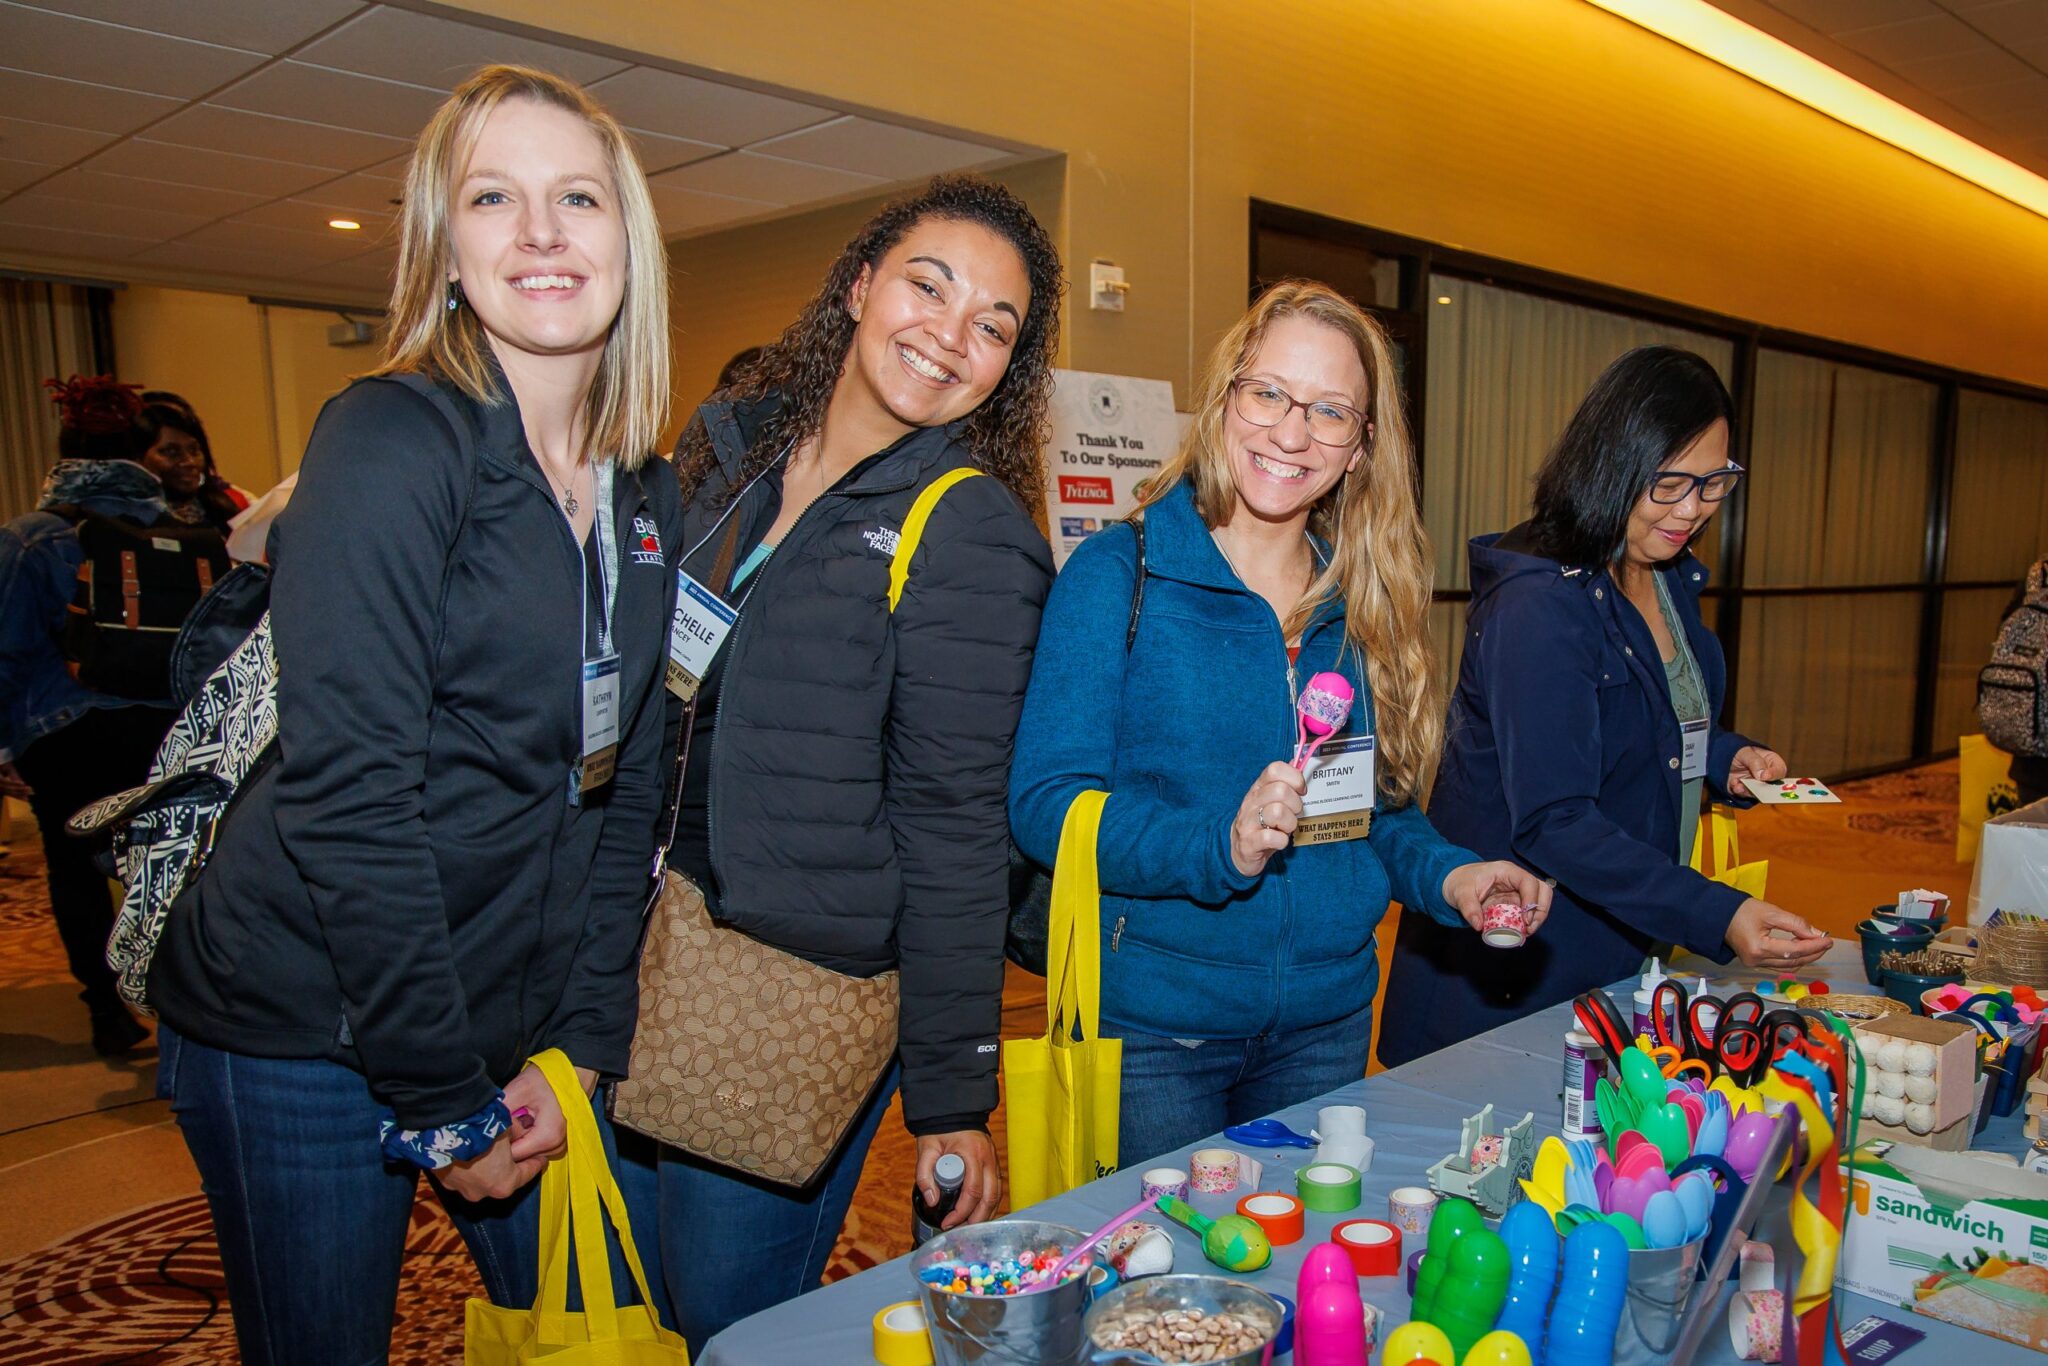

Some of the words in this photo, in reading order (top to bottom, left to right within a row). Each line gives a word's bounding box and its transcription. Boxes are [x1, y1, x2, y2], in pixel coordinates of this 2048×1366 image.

[1077, 433, 1117, 448] Thank
[1119, 436, 1144, 450] You
[1061, 451, 1078, 464] To
[1081, 452, 1104, 465] Our
[862, 530, 895, 547] NORTH
[879, 526, 896, 539] THE
[869, 540, 893, 555] FACE
[709, 600, 734, 622] CONFERENCE
[675, 670, 692, 687] HERE
[1312, 766, 1355, 779] BRITTANY
[1298, 824, 1316, 833] WHAT
[1317, 821, 1347, 831] HAPPENS
[1348, 818, 1364, 828] HERE
[1313, 832, 1332, 841] STAYS
[1333, 830, 1349, 839] HERE
[977, 1044, 997, 1053] 600
[1876, 1195, 2004, 1243] sandwich
[2032, 1251, 2048, 1261] 150
[1856, 1339, 1895, 1361] EQUIP
